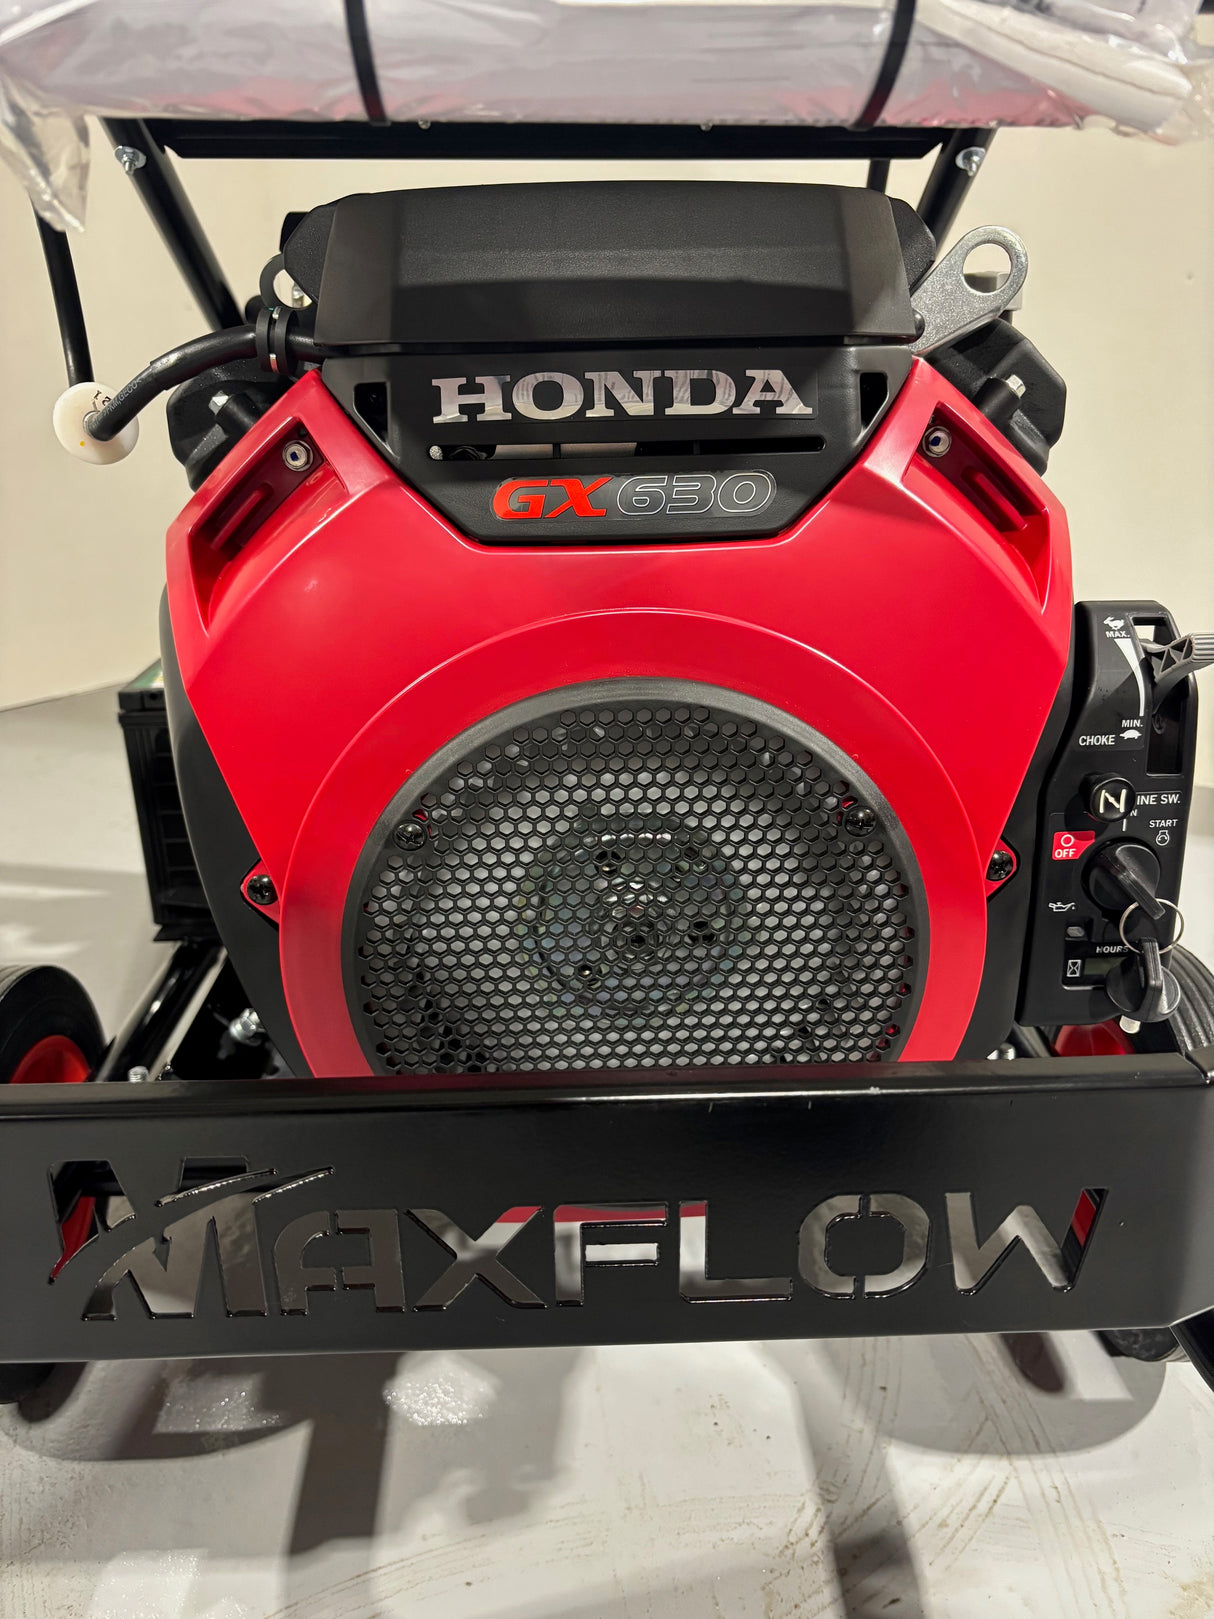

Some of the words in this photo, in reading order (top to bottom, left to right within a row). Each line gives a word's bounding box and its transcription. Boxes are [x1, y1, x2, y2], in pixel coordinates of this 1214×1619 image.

[431, 369, 813, 424] HONDA
[492, 476, 613, 520] GX
[616, 471, 777, 516] 630
[1105, 630, 1131, 639] MAX.
[1121, 719, 1144, 728] MIN.
[1078, 734, 1116, 746] CHOKE
[1136, 795, 1157, 806] INE
[1160, 793, 1181, 805] SW.
[1149, 818, 1178, 828] START
[1054, 848, 1077, 858] OFF
[1095, 945, 1129, 954] HOURS
[48, 1154, 1110, 1320] MAXFLOW
